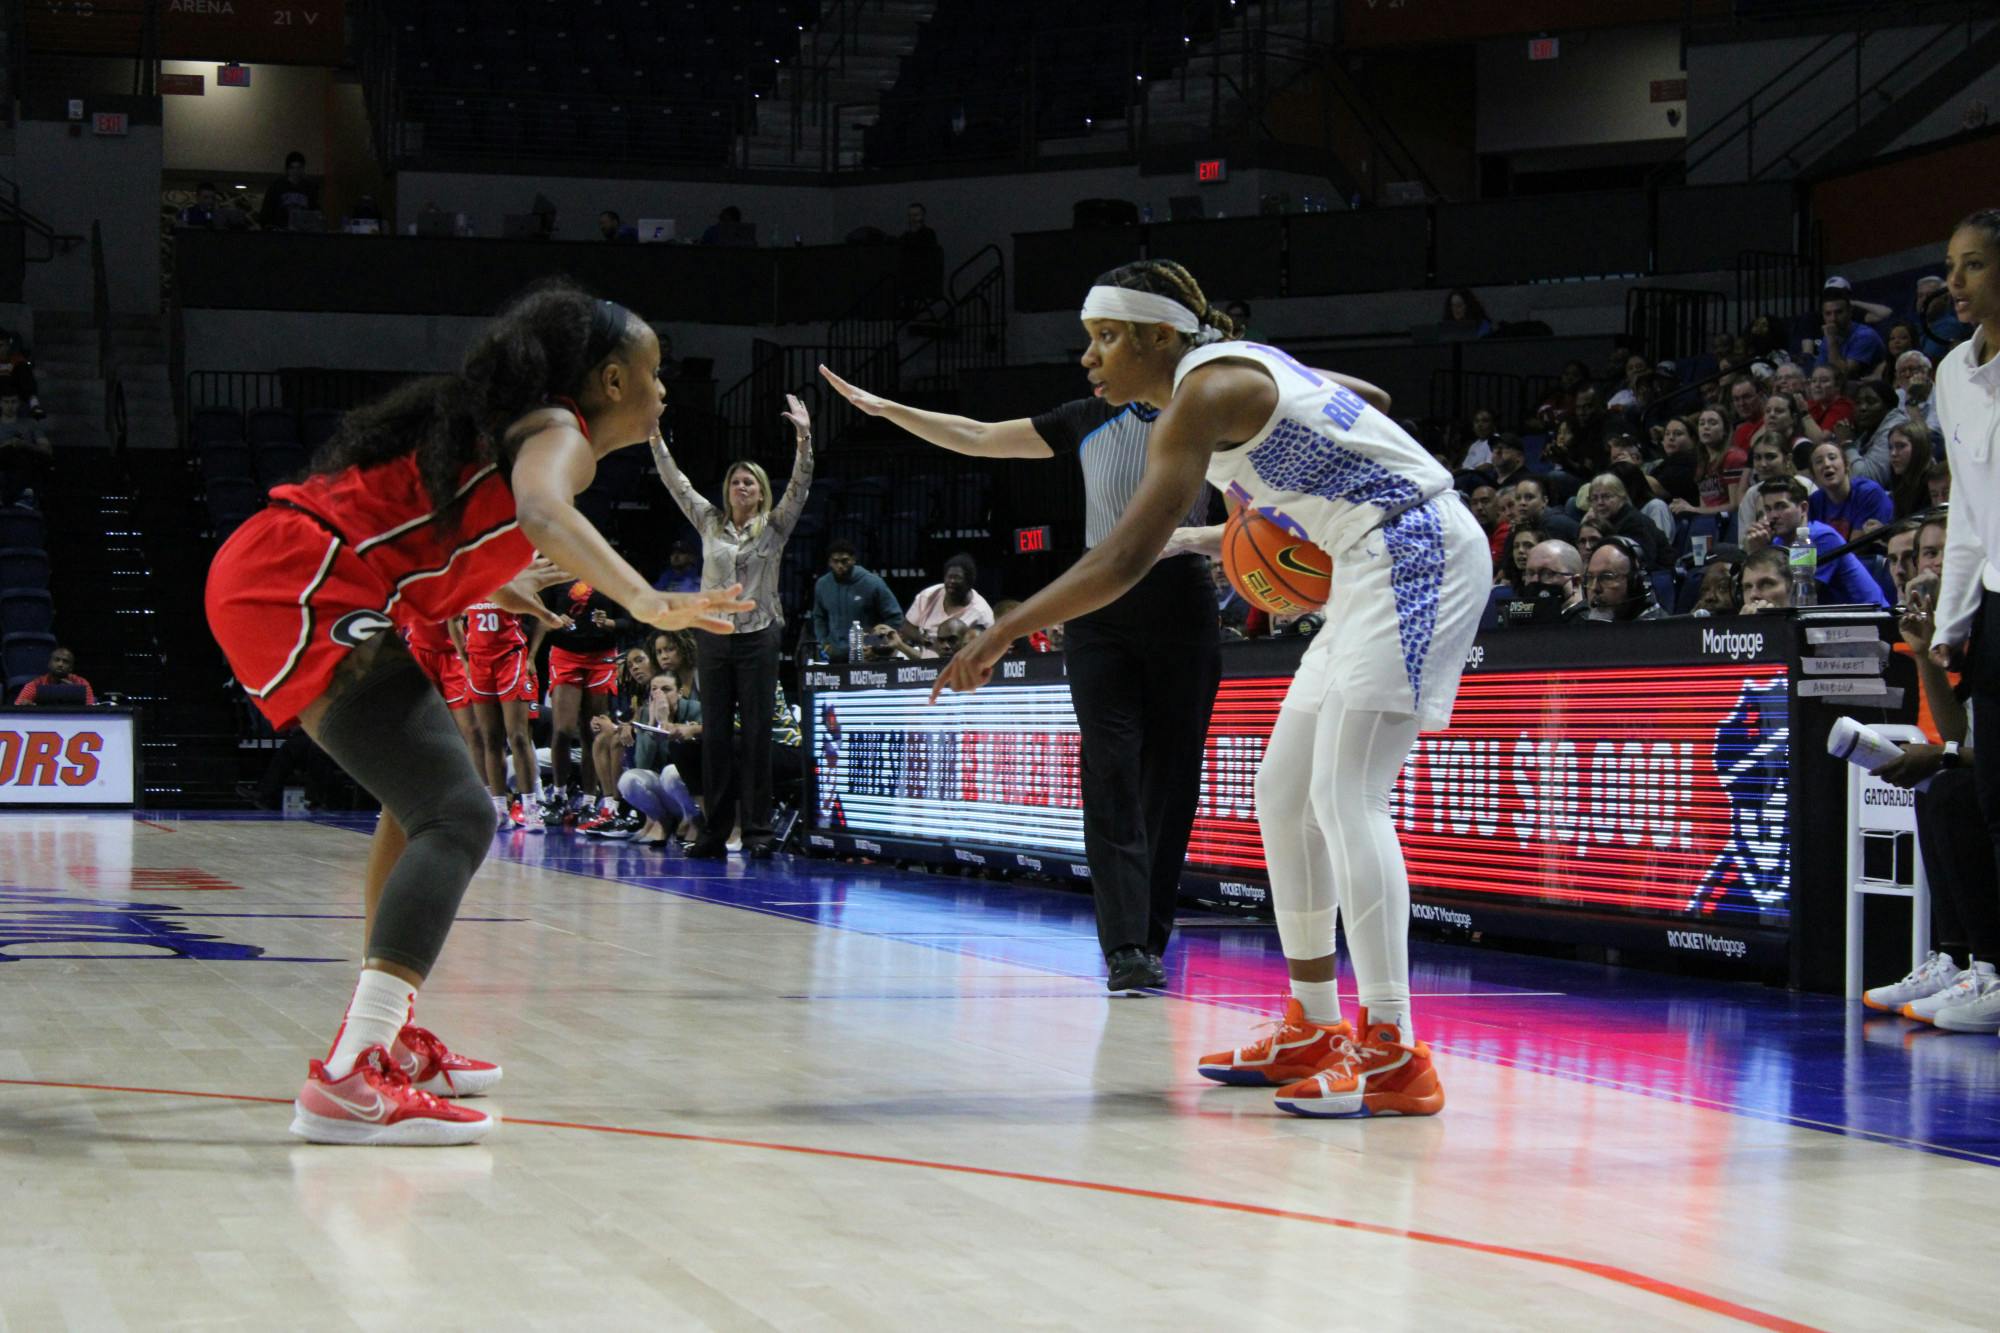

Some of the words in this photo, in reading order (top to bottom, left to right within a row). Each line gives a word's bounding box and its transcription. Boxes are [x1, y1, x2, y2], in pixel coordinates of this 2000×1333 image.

[169, 0, 234, 14] ARENA
[274, 10, 292, 25] 21
[97, 115, 120, 132] EXIT
[1199, 160, 1220, 182] EXIT
[1019, 528, 1043, 551] EXIT
[476, 612, 499, 632] 20
[1702, 628, 1764, 660] Mortgage
[848, 731, 886, 795] DRIVE
[888, 731, 934, 799] SOBER
[938, 731, 957, 800] OR
[962, 731, 989, 801] GET
[992, 731, 1050, 805] PULLED
[1425, 740, 1499, 836] YOU
[1512, 731, 1694, 858] $10,000!
[1864, 788, 1914, 807] GATORADE
[1440, 907, 1472, 928] Mortgage
[1667, 930, 1704, 950] ROCKET
[1704, 933, 1747, 958] Mortgage
